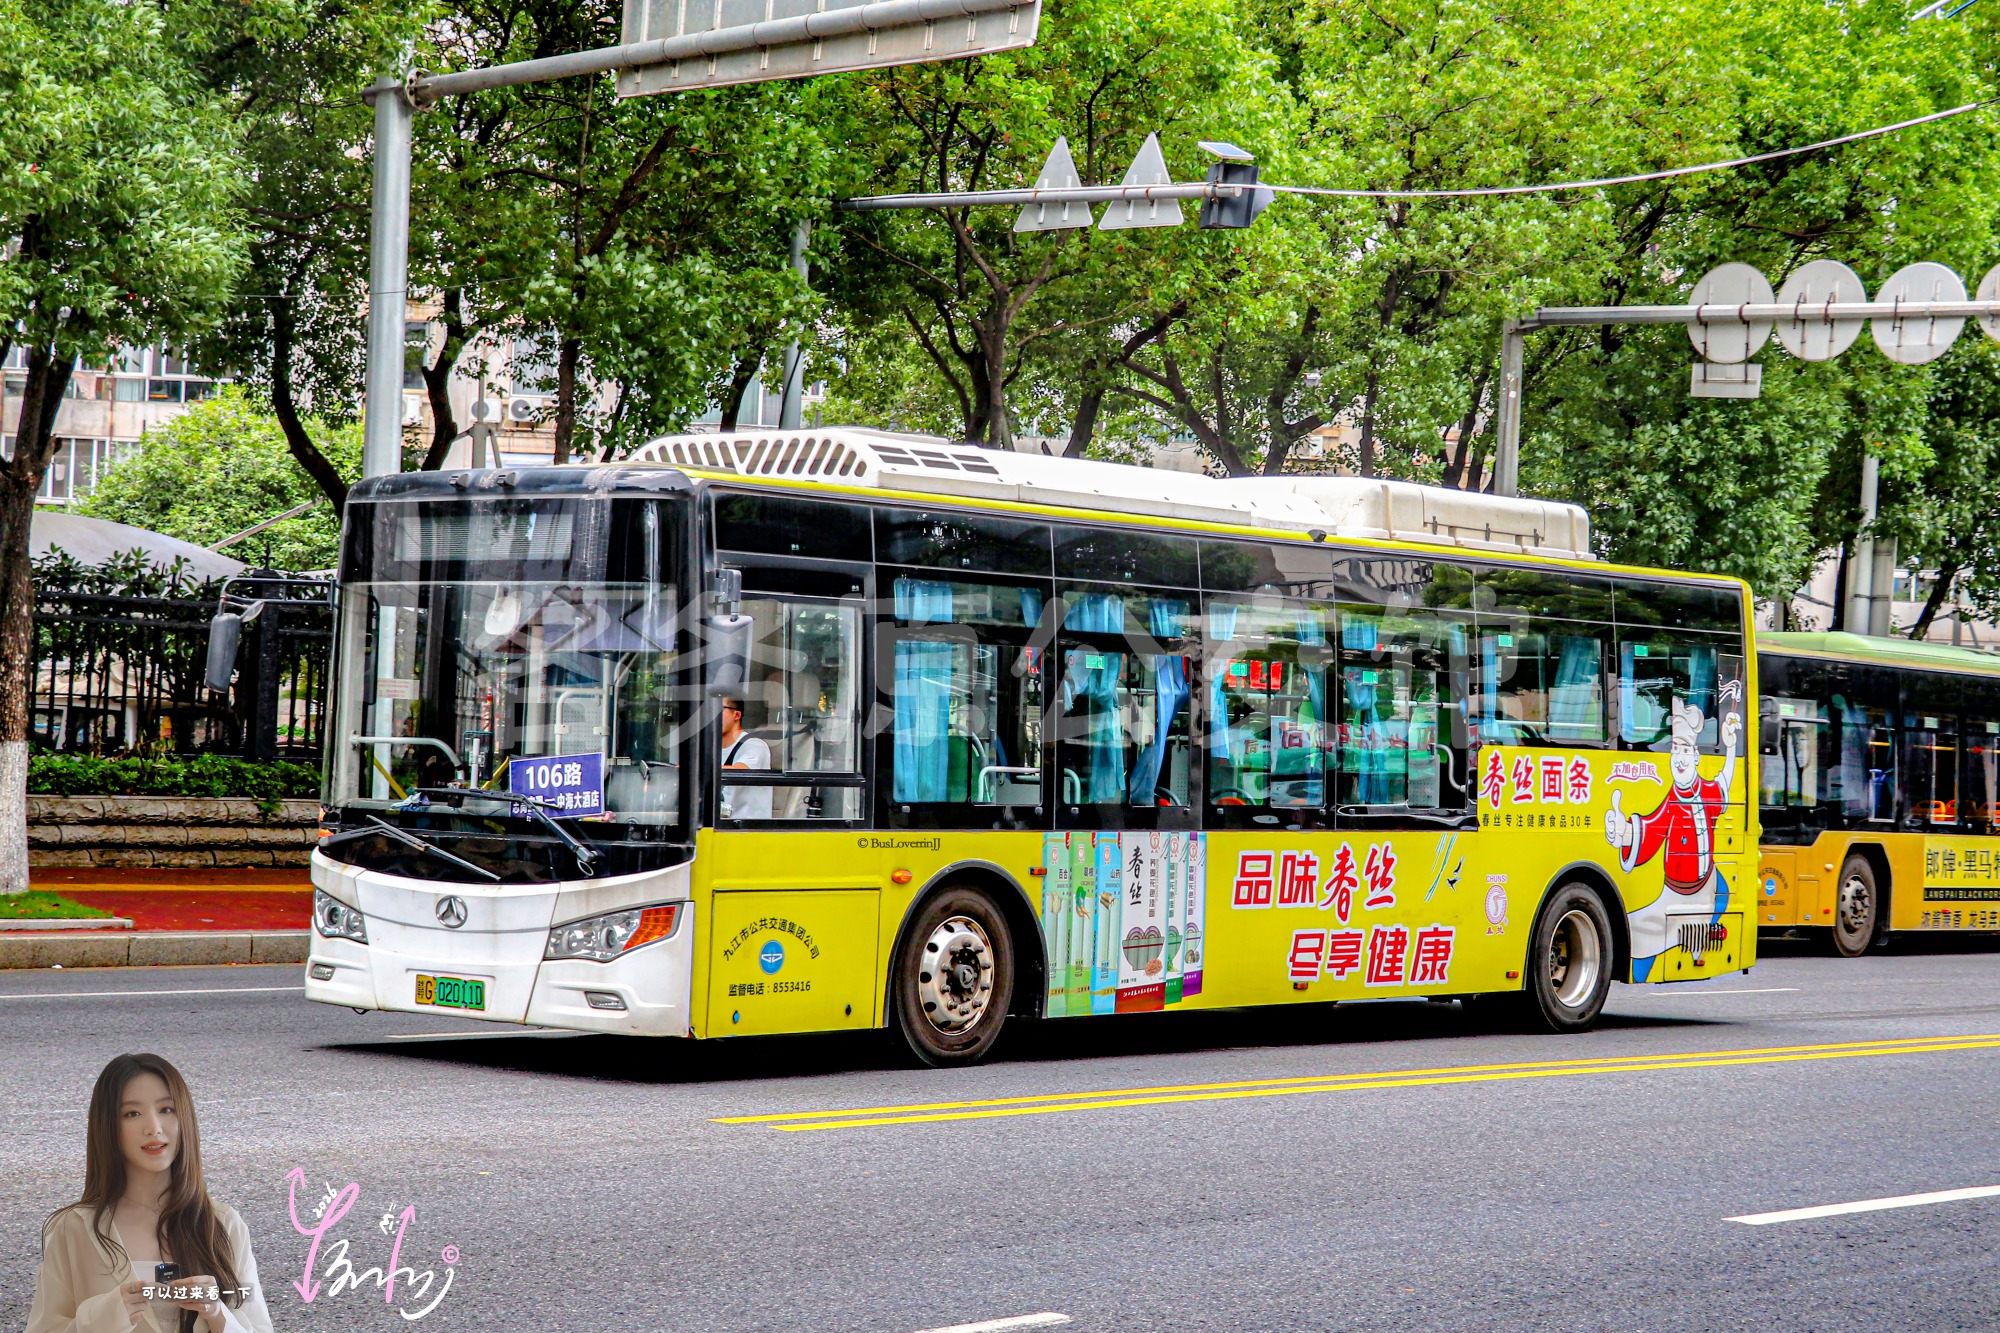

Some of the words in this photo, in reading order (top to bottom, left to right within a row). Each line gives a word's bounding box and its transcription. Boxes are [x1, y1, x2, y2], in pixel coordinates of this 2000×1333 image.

[525, 761, 582, 790] 106路
[1480, 752, 1590, 808] 春丝面条
[1482, 813, 1591, 828] 春丝专注健康食品30年
[1126, 845, 1144, 906] 春丝
[1233, 843, 1397, 923] 品味春丝
[723, 917, 820, 961] 九江市公共交通集团公司
[1289, 926, 1454, 984] 尽享健康
